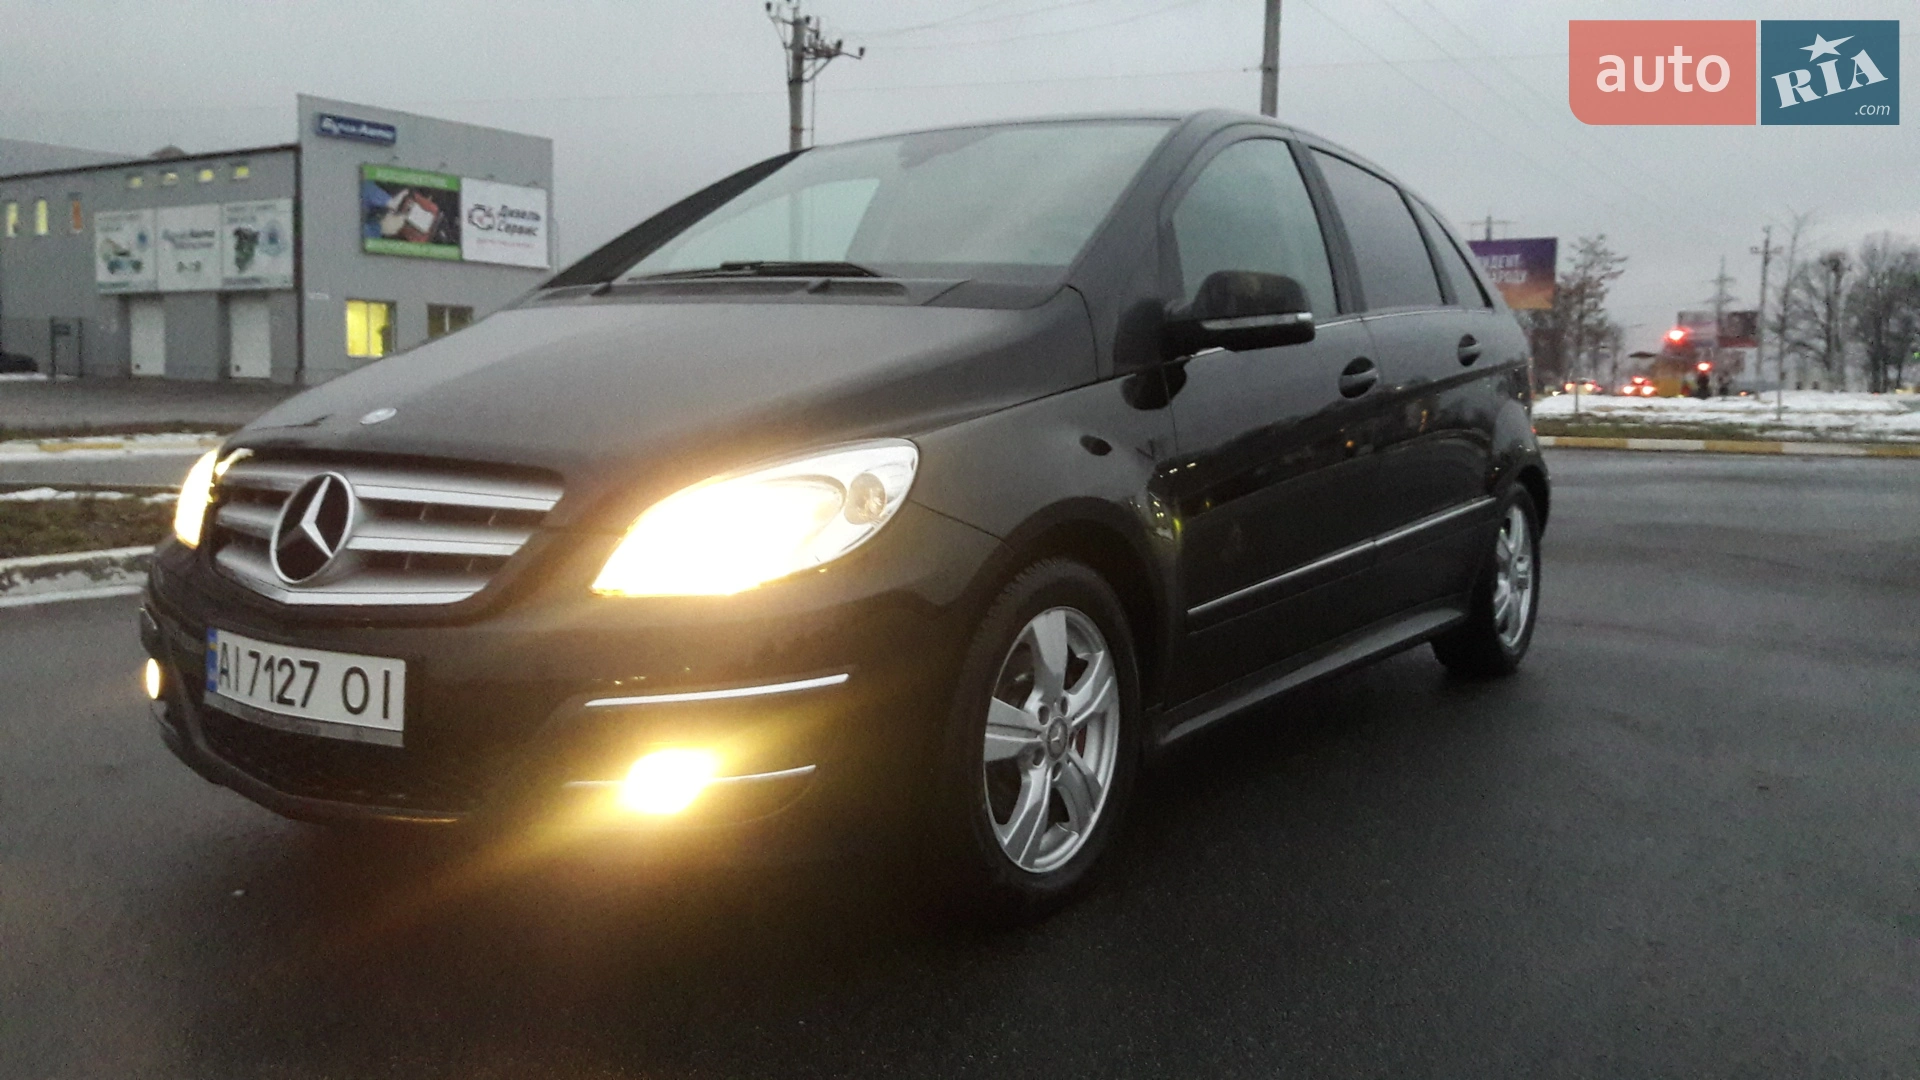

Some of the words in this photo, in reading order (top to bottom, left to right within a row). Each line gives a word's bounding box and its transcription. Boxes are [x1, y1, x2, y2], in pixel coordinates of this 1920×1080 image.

[497, 204, 541, 222] Дизель
[496, 220, 538, 237] Сервис
[341, 665, 391, 719] OI
